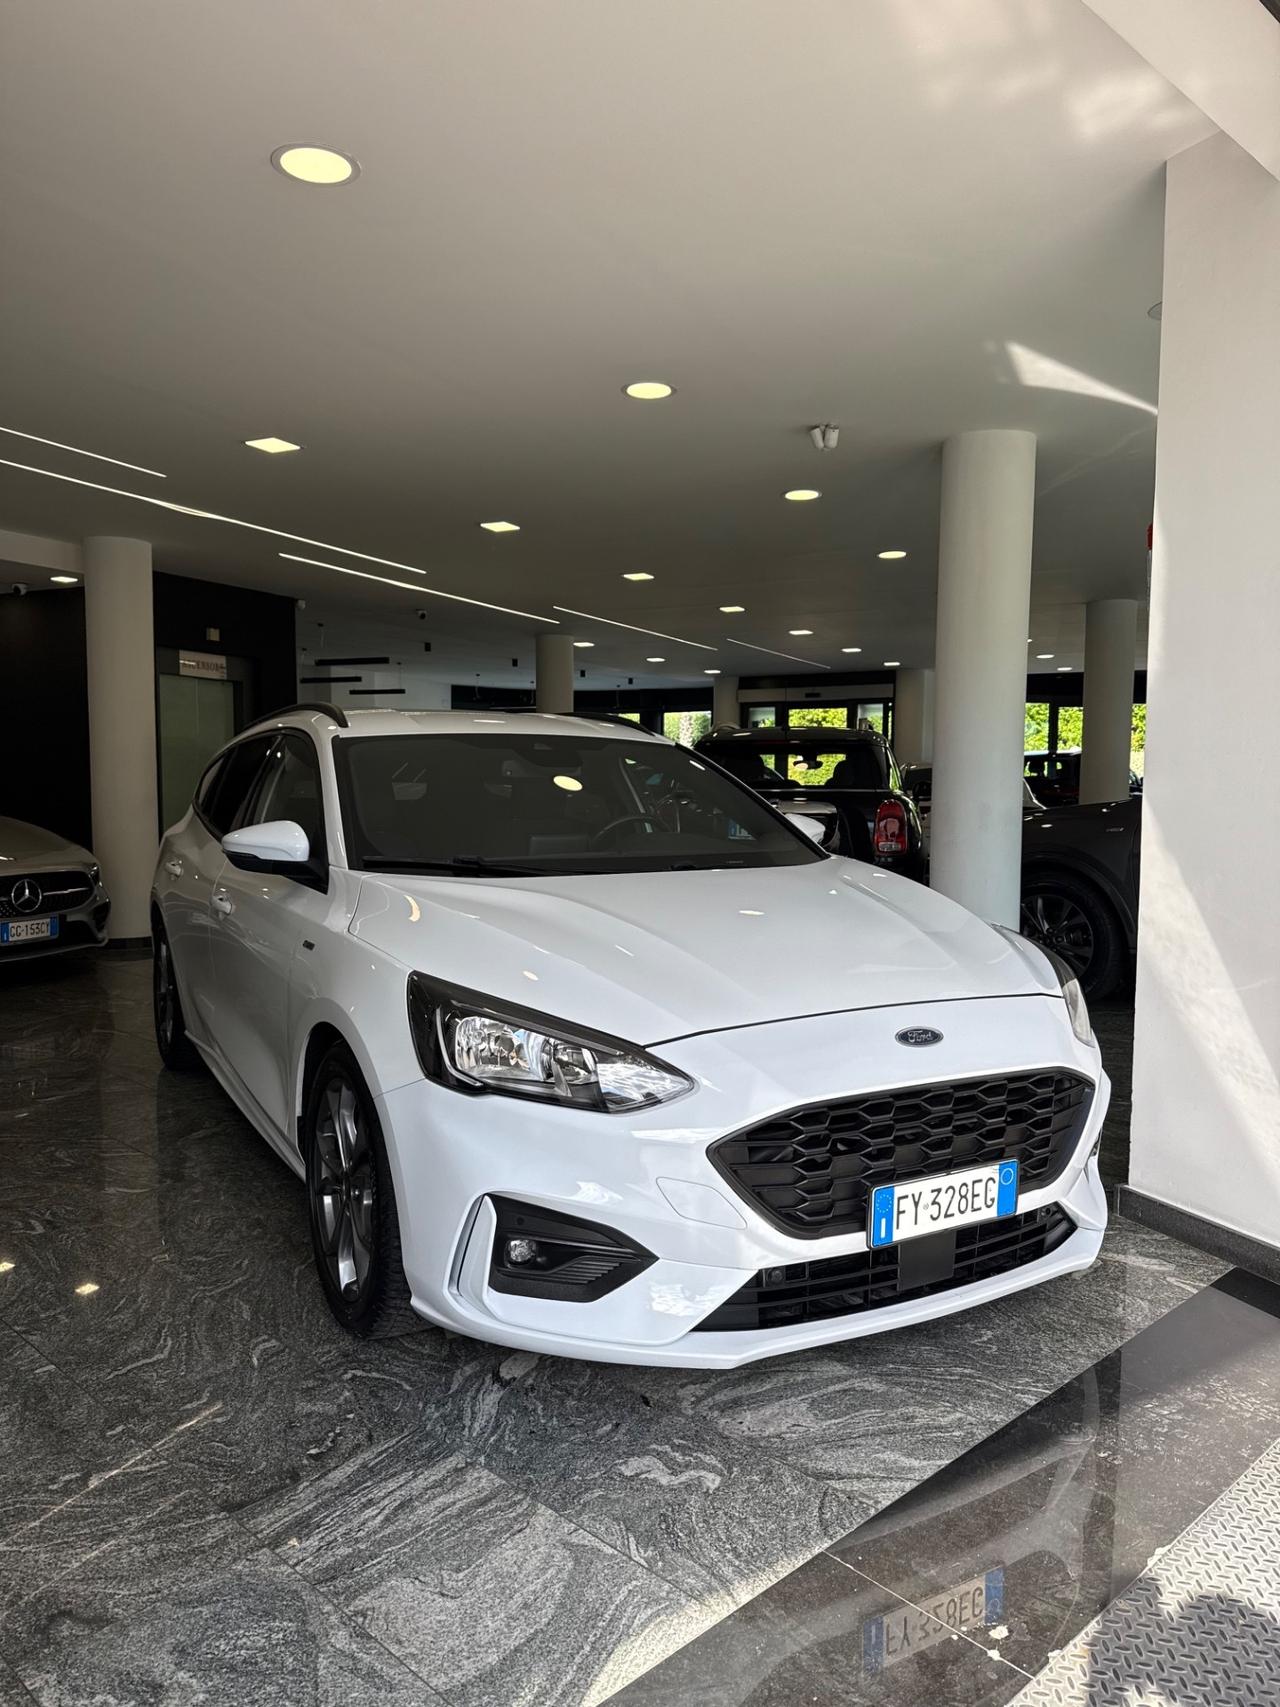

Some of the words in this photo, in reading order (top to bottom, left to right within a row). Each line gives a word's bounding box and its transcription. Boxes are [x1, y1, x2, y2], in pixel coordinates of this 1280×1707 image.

[907, 1030, 932, 1043] Ford
[896, 1191, 923, 1230] FY
[930, 1177, 996, 1221] 328EG
